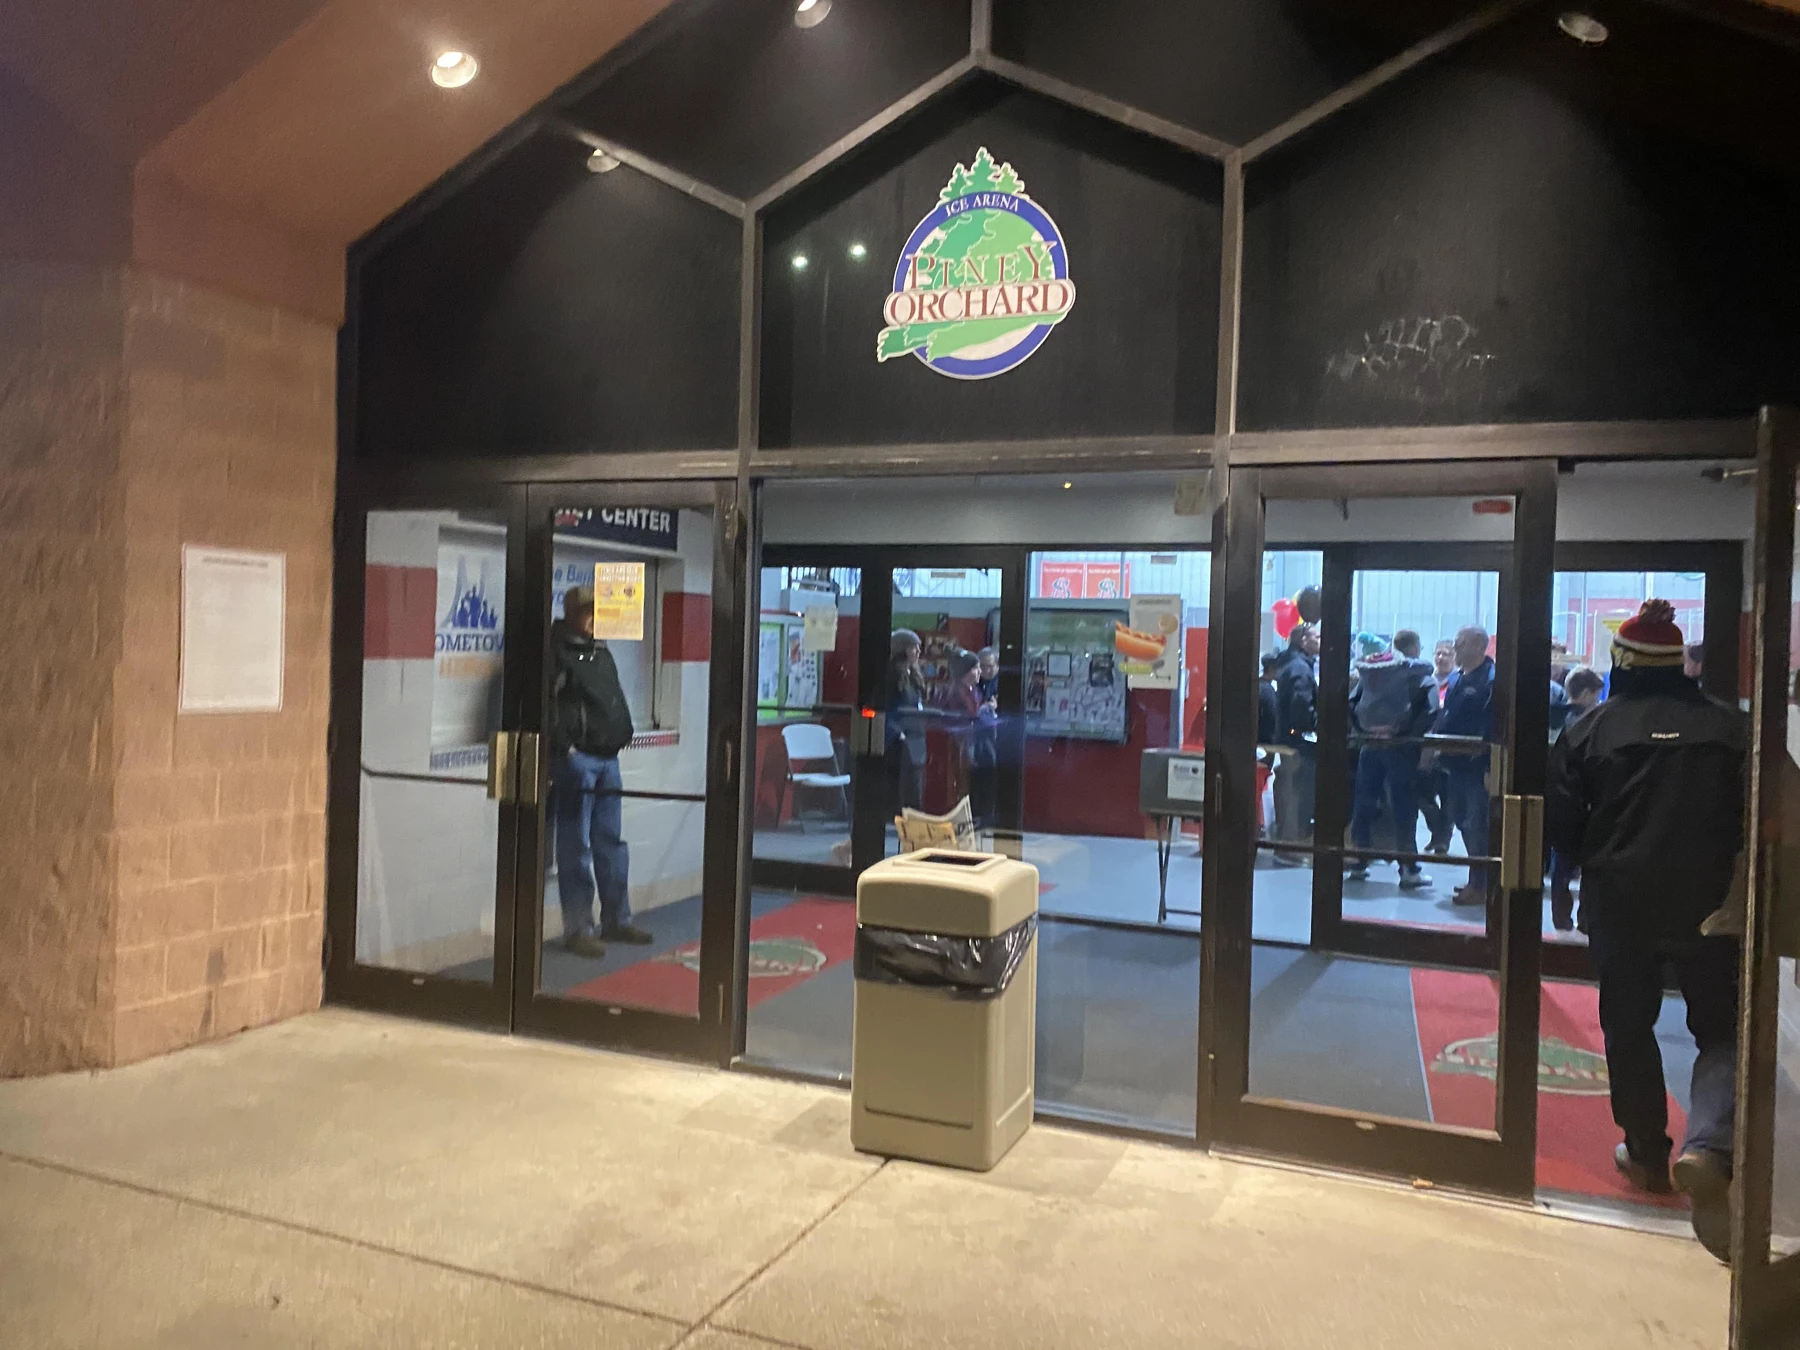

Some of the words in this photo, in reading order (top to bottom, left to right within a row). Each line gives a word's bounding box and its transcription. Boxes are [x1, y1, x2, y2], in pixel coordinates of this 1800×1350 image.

[945, 198, 969, 217] ICE
[973, 193, 1019, 213] ARENA
[905, 241, 1057, 291] PINEY
[890, 283, 1069, 323] ORCHARD
[601, 507, 670, 533] CENTER
